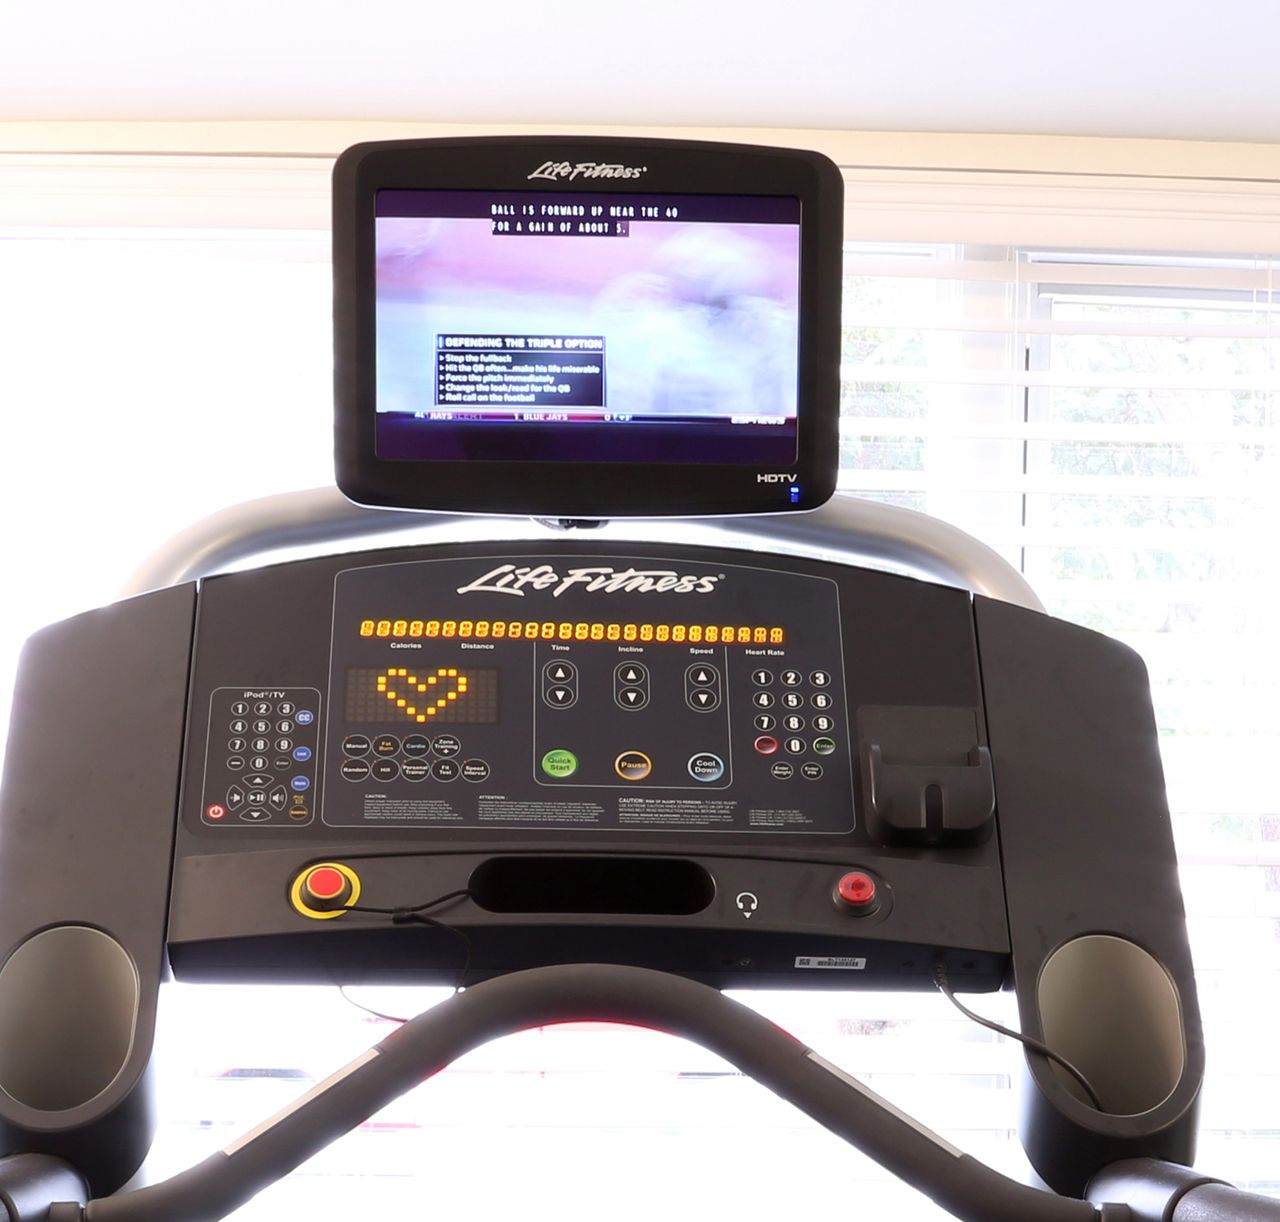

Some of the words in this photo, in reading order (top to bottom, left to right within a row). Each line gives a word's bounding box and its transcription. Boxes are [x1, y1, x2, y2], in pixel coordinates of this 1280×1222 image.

[527, 161, 571, 181] Life
[569, 162, 642, 181] Fitness
[491, 204, 515, 215] BALL
[523, 205, 534, 216] IS
[542, 205, 585, 216] FORWARD
[591, 206, 603, 216] UP
[610, 206, 634, 217] NEAR
[641, 207, 658, 218] THE
[666, 207, 678, 218] 40
[492, 221, 510, 232] FOR
[516, 222, 522, 232] A
[528, 222, 554, 232] GAIN
[560, 222, 571, 232] OF
[578, 222, 609, 233] ABOUT
[445, 338, 502, 348] DEFENDING
[505, 338, 524, 348] THE
[527, 338, 562, 348] TRIPLE
[564, 339, 602, 349] OPTION
[445, 354, 464, 363] Stop
[472, 365, 484, 373] QB
[483, 374, 503, 383] pitch
[504, 374, 555, 384] immediately
[445, 384, 474, 393] Change
[558, 384, 570, 393] QB
[757, 474, 798, 483] HDTV
[457, 564, 559, 596] Life
[553, 568, 718, 597] Fitness
[758, 672, 765, 684] 1
[786, 672, 796, 684] 2
[816, 673, 824, 684] 3
[759, 694, 768, 706] 4
[788, 695, 797, 706] 5
[817, 696, 826, 707] 6
[761, 717, 769, 728] 7
[790, 717, 798, 728] 8
[819, 718, 828, 729] 9
[791, 740, 800, 751] 0
